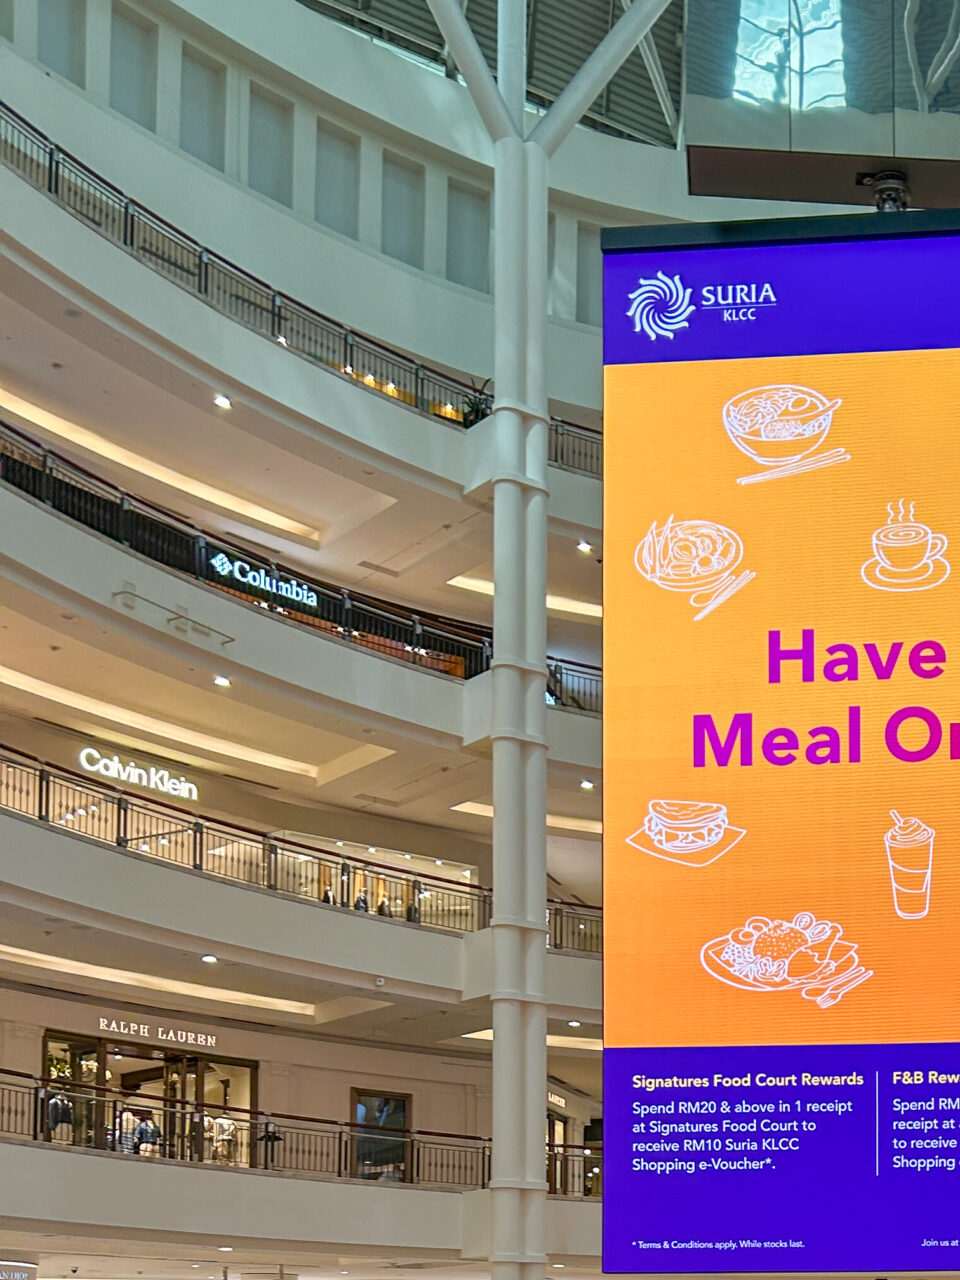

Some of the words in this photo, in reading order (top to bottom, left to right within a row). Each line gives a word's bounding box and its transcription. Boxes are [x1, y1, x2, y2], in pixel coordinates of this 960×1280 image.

[701, 283, 777, 306] SURIA
[723, 308, 757, 322] KLCC
[233, 560, 318, 607] Columbia
[768, 628, 947, 684] Have
[693, 706, 861, 768] Meal
[79, 747, 148, 786] Calvin
[149, 766, 199, 800] Klein
[99, 1017, 150, 1037] RALPH
[157, 1027, 216, 1047] LAUREN
[632, 1075, 709, 1091] Signatures
[713, 1074, 751, 1087] Food
[755, 1073, 797, 1087] Court
[801, 1072, 864, 1086] Rewards
[892, 1071, 924, 1084] F&B
[632, 1101, 674, 1117] Spend
[678, 1101, 717, 1114] RM20
[720, 1101, 731, 1114] &
[735, 1100, 775, 1113] above
[778, 1100, 791, 1113] in
[795, 1100, 802, 1113] 1
[806, 1099, 853, 1116] receipt
[892, 1098, 935, 1114] Spend
[632, 1122, 646, 1133] at
[649, 1120, 719, 1136] Signatures
[722, 1119, 757, 1132] Food
[760, 1119, 798, 1132] Court
[802, 1121, 816, 1132] to
[892, 1117, 939, 1133] receipt
[942, 1118, 956, 1129] at
[632, 1138, 680, 1152] receive
[683, 1139, 722, 1151] RM10
[725, 1138, 758, 1151] Suria
[762, 1137, 800, 1150] KLCC
[892, 1138, 907, 1149] to
[910, 1135, 957, 1149] receive
[632, 1158, 695, 1174] Shopping
[892, 1155, 955, 1171] Shopping
[638, 1241, 662, 1249] Terms
[663, 1241, 669, 1249] &
[671, 1240, 713, 1249] Conditions
[739, 1239, 762, 1248] While
[763, 1240, 788, 1248] stocks
[921, 1238, 938, 1247] Join
[939, 1239, 949, 1247] us
[951, 1239, 959, 1247] at
